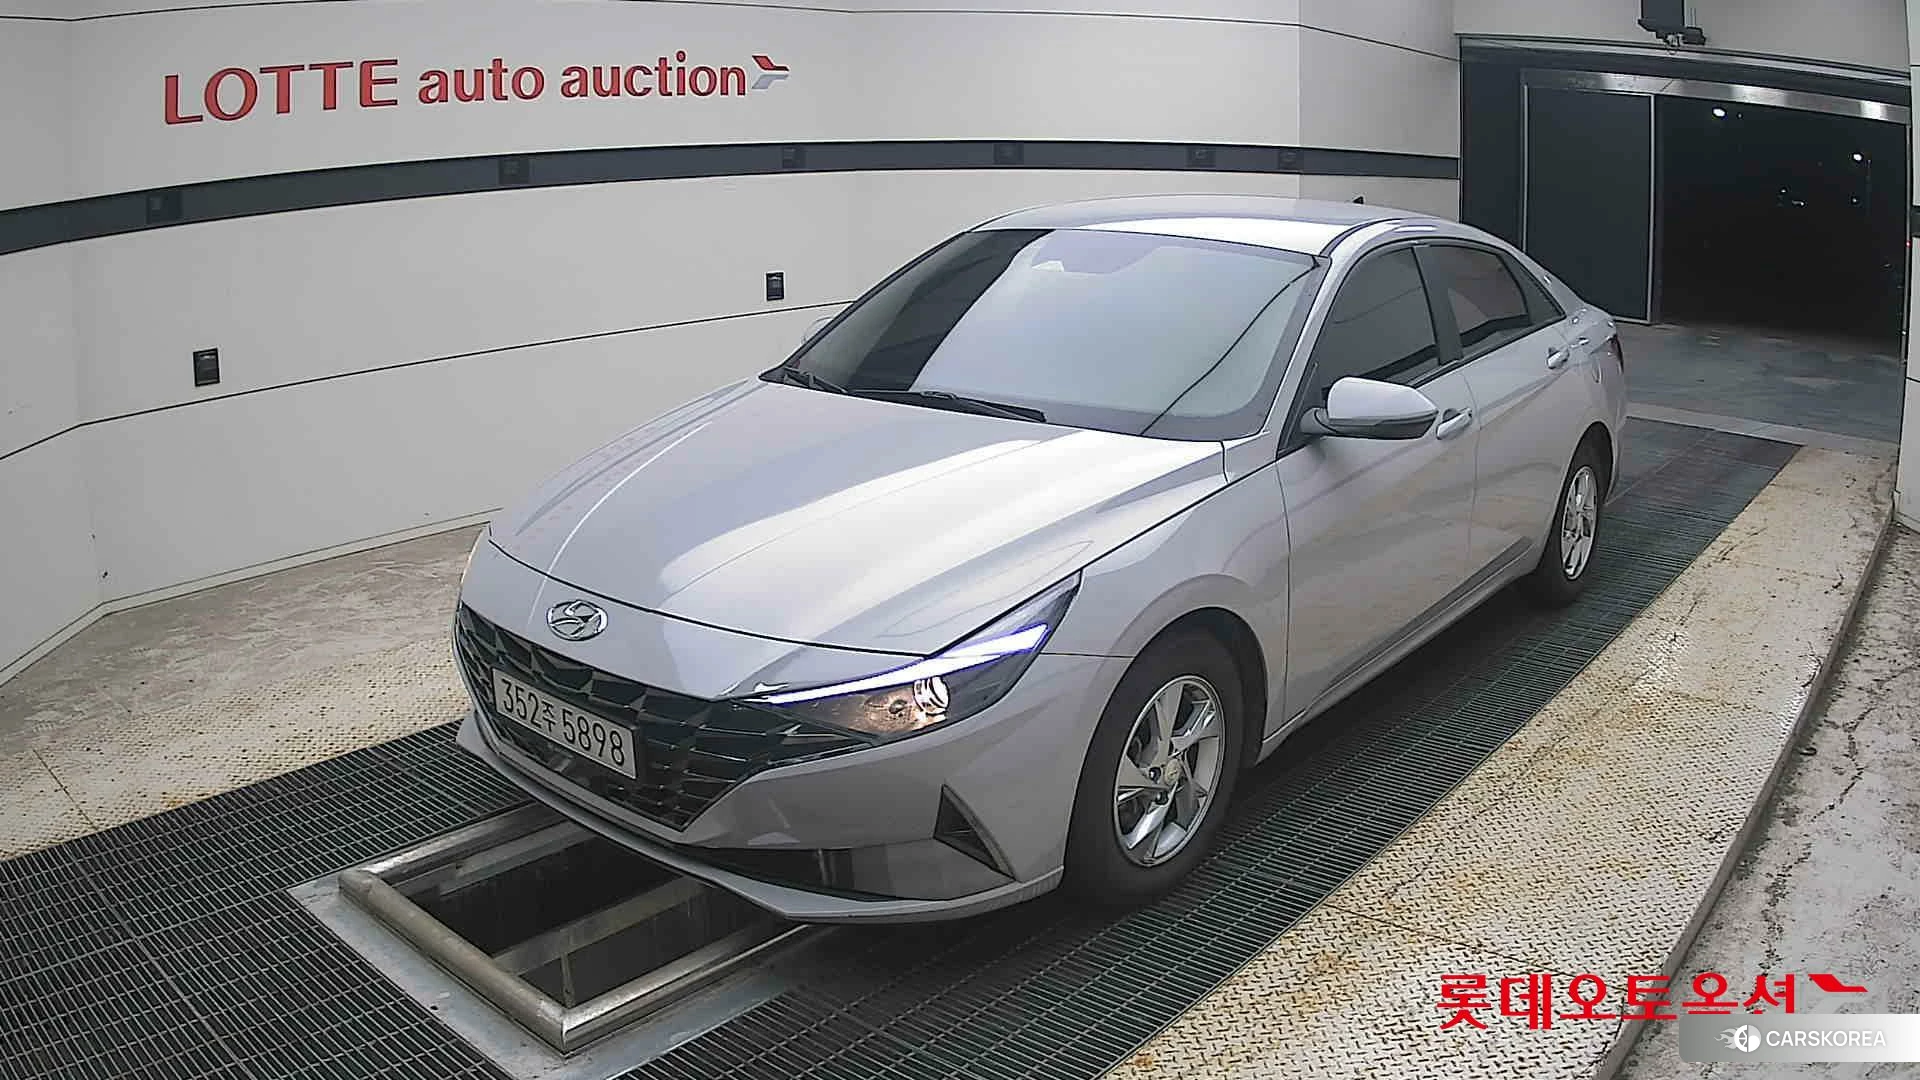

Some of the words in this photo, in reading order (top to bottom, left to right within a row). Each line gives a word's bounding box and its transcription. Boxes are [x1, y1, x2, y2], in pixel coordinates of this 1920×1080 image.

[164, 58, 399, 125] LOTTE
[418, 57, 546, 105] auto
[560, 50, 747, 98] auction
